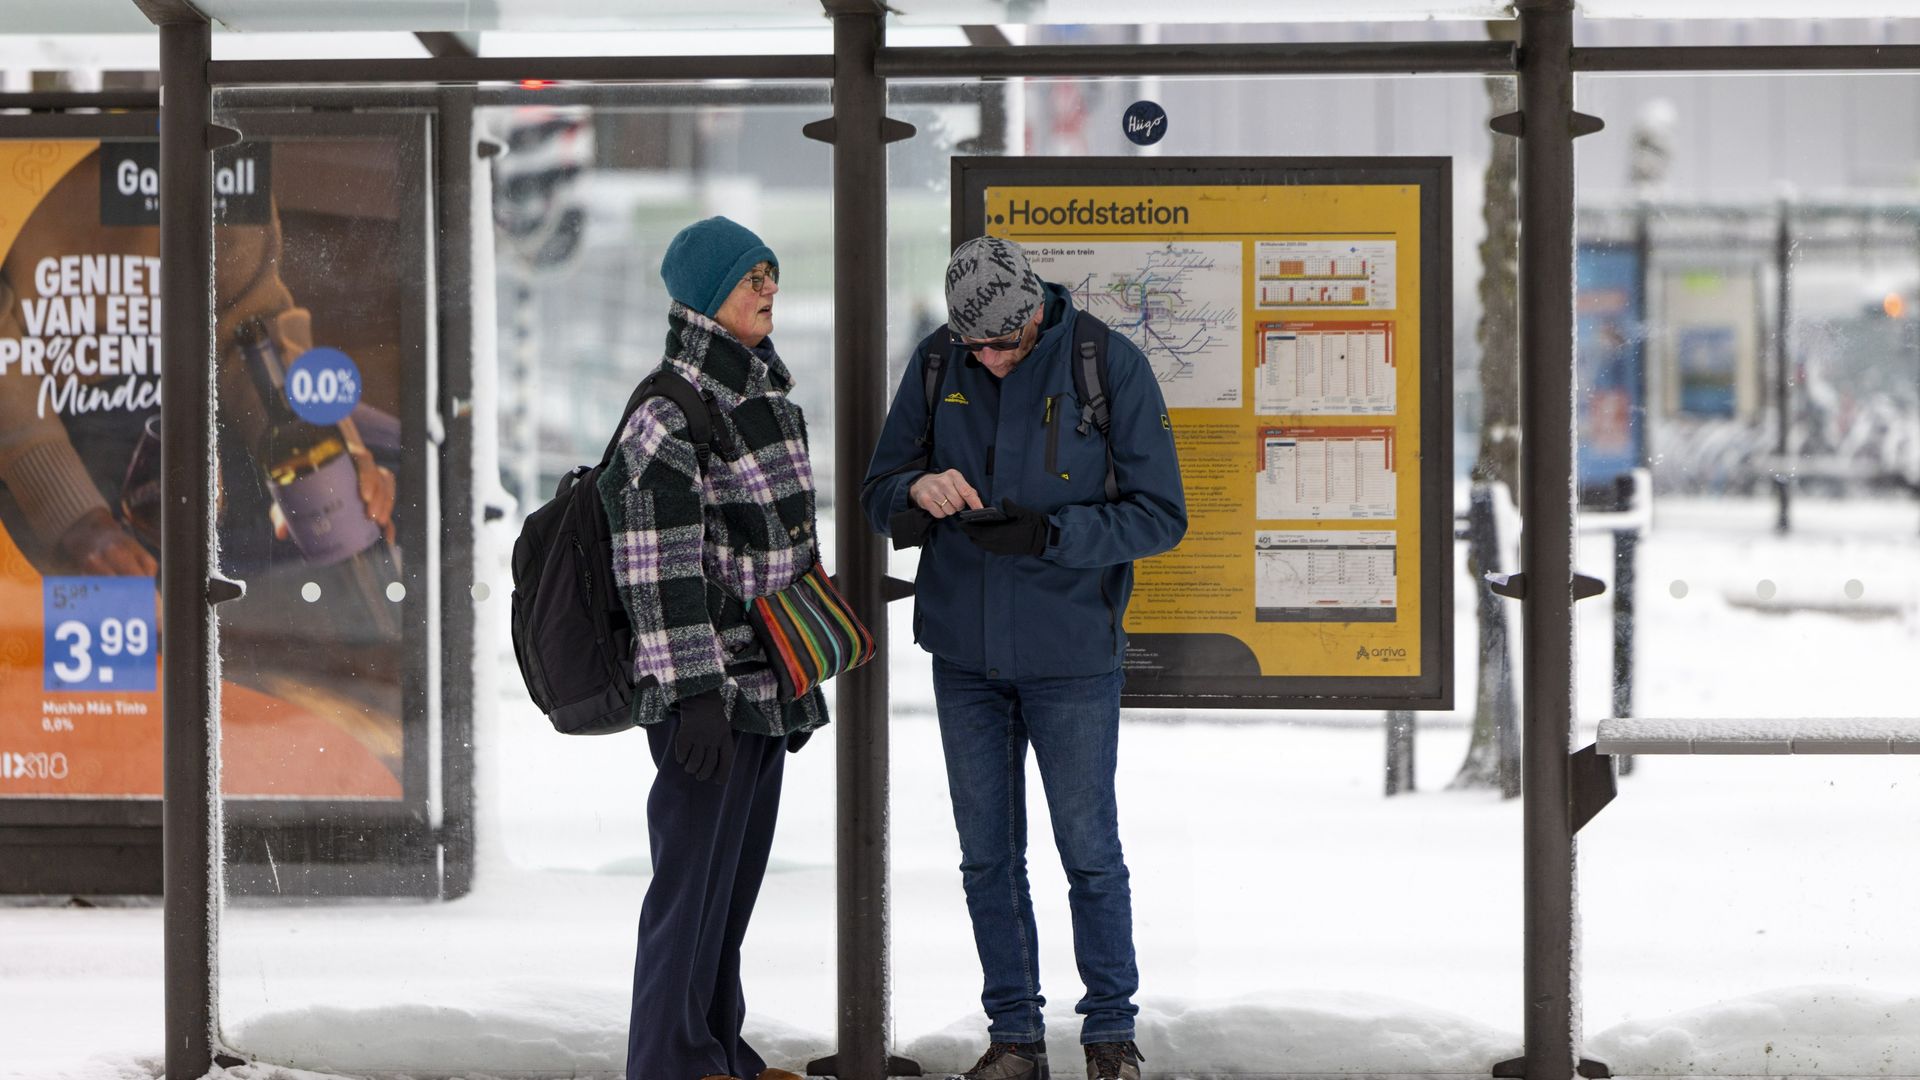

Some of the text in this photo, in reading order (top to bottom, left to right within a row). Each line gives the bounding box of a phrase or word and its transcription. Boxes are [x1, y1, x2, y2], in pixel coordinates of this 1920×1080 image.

[1009, 198, 1189, 226] Hoofdstation
[1042, 248, 1064, 256] Q-link
[1077, 248, 1095, 256] trein
[34, 254, 161, 297] GENIET
[21, 296, 96, 336] VAN
[292, 367, 356, 404] 0.0%
[1258, 536, 1272, 544] 401
[53, 617, 149, 684] 3.99
[1371, 646, 1407, 657] arriva
[42, 700, 148, 715] Mucho Más Tinto
